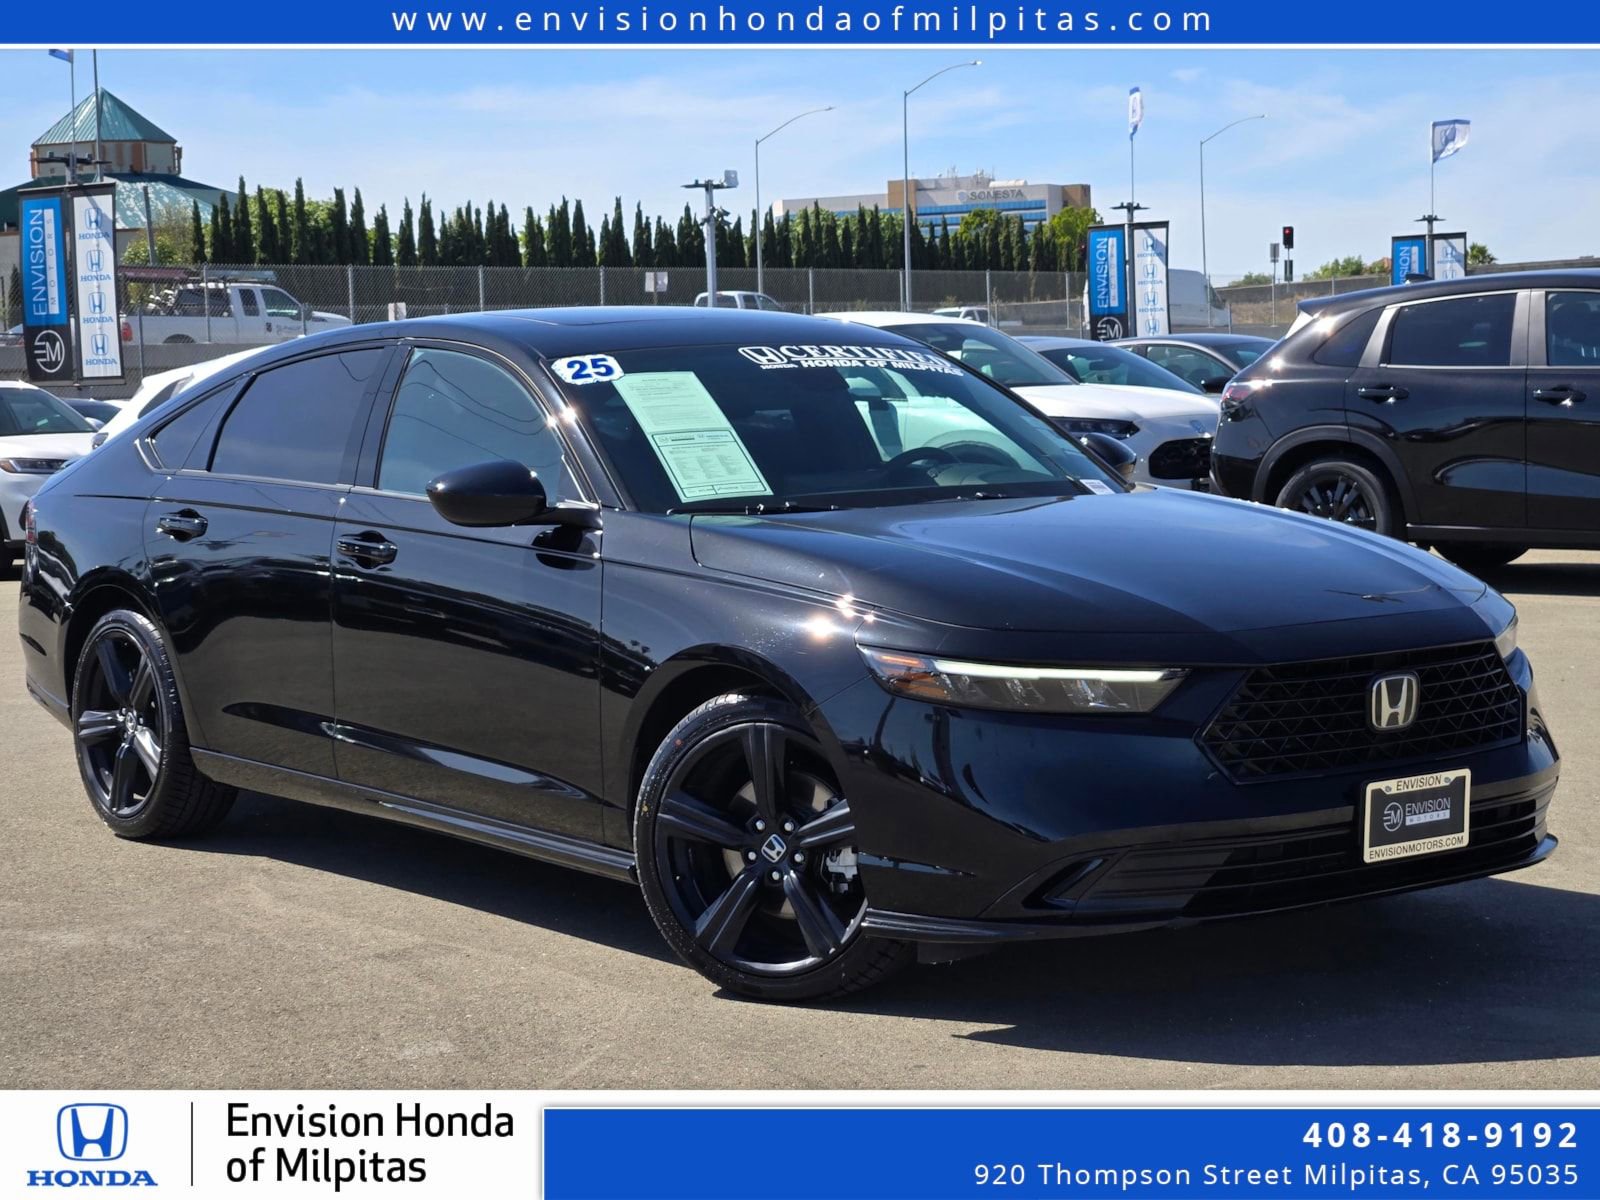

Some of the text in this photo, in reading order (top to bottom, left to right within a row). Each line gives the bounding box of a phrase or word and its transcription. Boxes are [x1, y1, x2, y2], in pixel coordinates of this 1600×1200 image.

[970, 189, 1024, 201] SONESTA
[79, 231, 110, 240] HONDA
[30, 208, 47, 315] ENVISION
[80, 273, 111, 282] HONDA
[1096, 237, 1109, 309] ENVISION
[82, 315, 114, 324] HONDA
[85, 357, 118, 366] HONDA
[779, 345, 951, 368] CERTIFIED
[566, 357, 615, 380] 25
[801, 359, 964, 376] HONDA OF MILPITAS
[1396, 775, 1441, 791] ENVISION
[1406, 797, 1451, 815] ENVISION
[1369, 836, 1464, 859] ENVISIONMOTORS.COM
